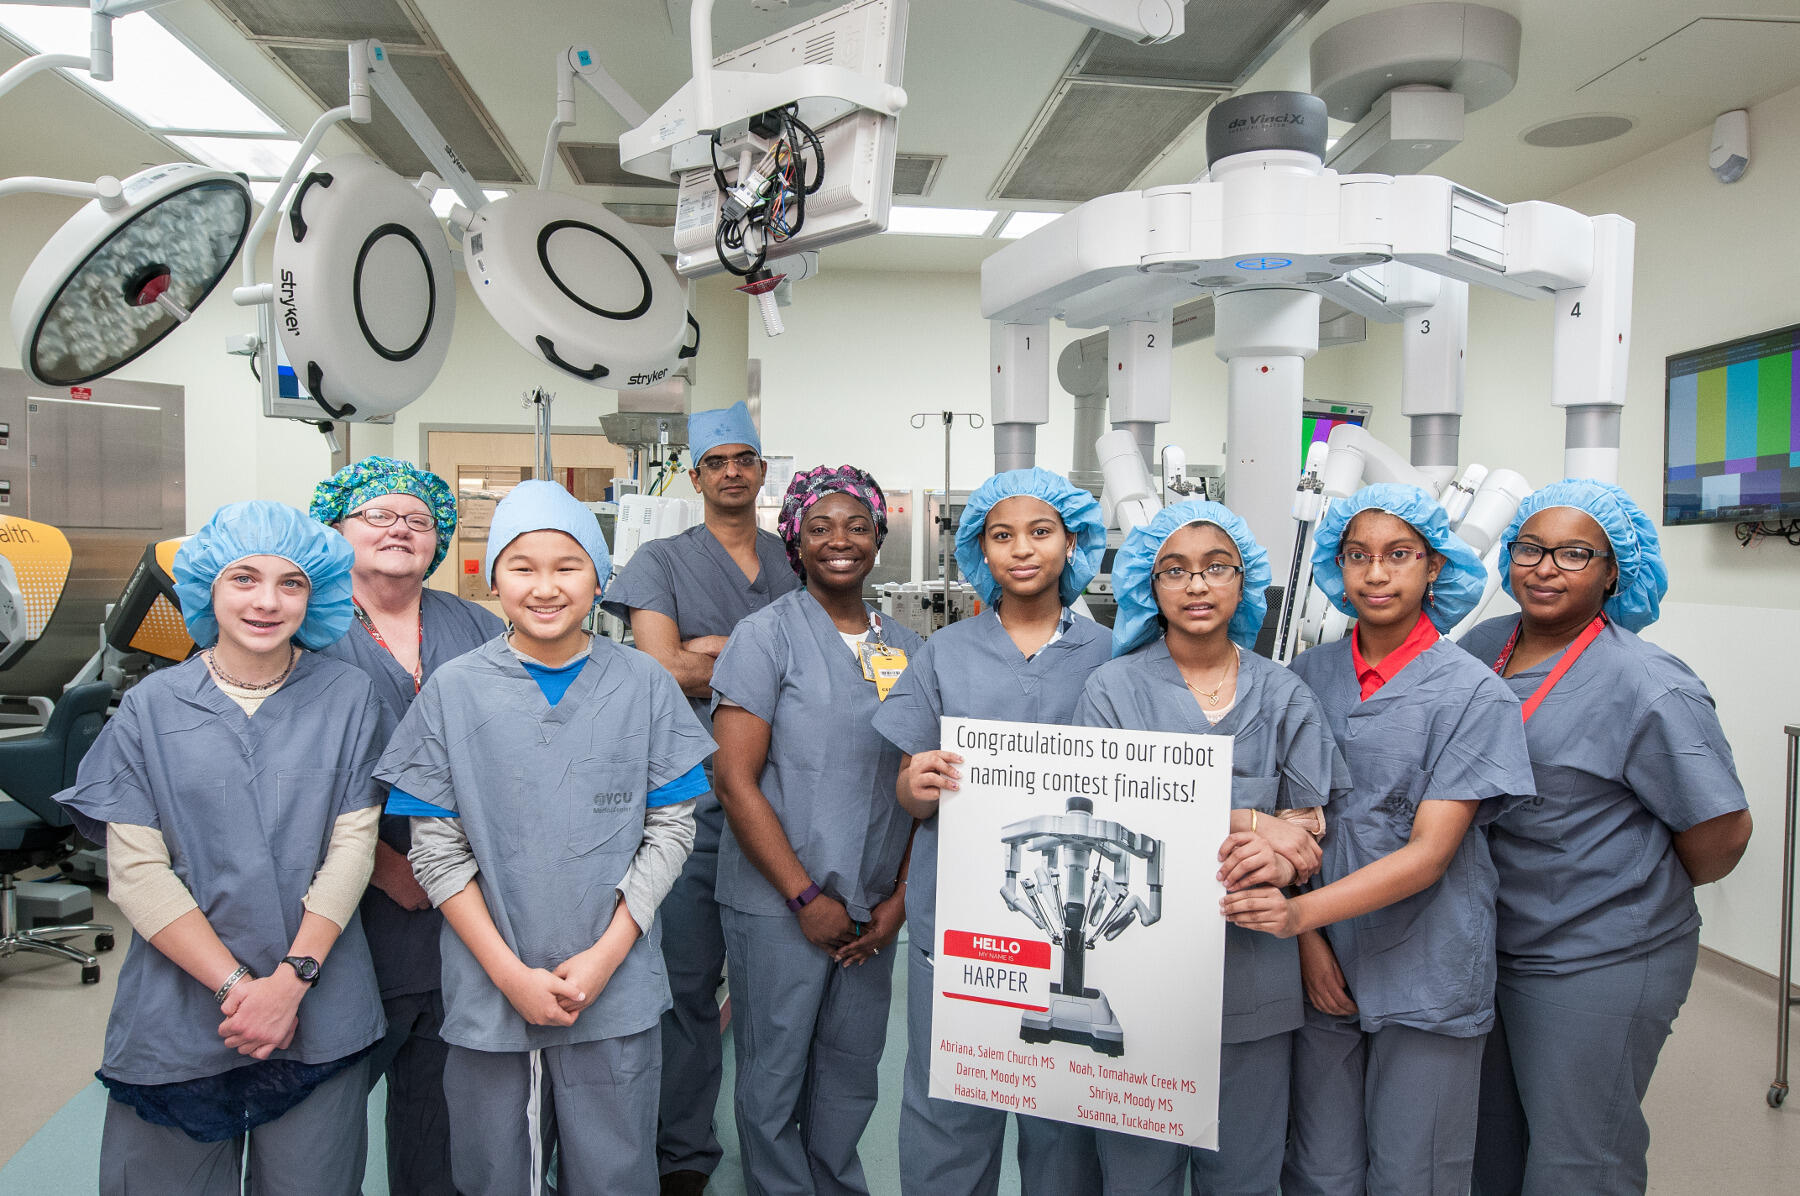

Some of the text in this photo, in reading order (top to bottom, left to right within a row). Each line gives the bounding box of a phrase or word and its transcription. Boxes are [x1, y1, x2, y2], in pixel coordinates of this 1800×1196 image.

[445, 144, 467, 174] stryker
[280, 268, 300, 336] stryker
[1570, 302, 1582, 318] 4
[1420, 319, 1431, 334] 3
[1026, 336, 1030, 350] 1
[1147, 334, 1155, 348] 2
[627, 367, 668, 385] stryker
[957, 725, 1214, 767] Congratulations to our robot
[971, 764, 1196, 803] naming contest finalists!
[606, 791, 633, 805] VCU
[973, 936, 1021, 954] HELLO
[963, 964, 1028, 993] HARPER
[940, 1039, 1055, 1070] Abriana, Salem Church MS
[956, 1062, 1037, 1088] Darren, Moody MS
[1069, 1060, 1197, 1094] Noah, Tomahawk Creek MS
[954, 1083, 1037, 1110] Haasita, Moody MS
[1089, 1085, 1173, 1112] Shriya, Moody MS
[1077, 1105, 1184, 1137] Susanna, Tuckahoe MS
